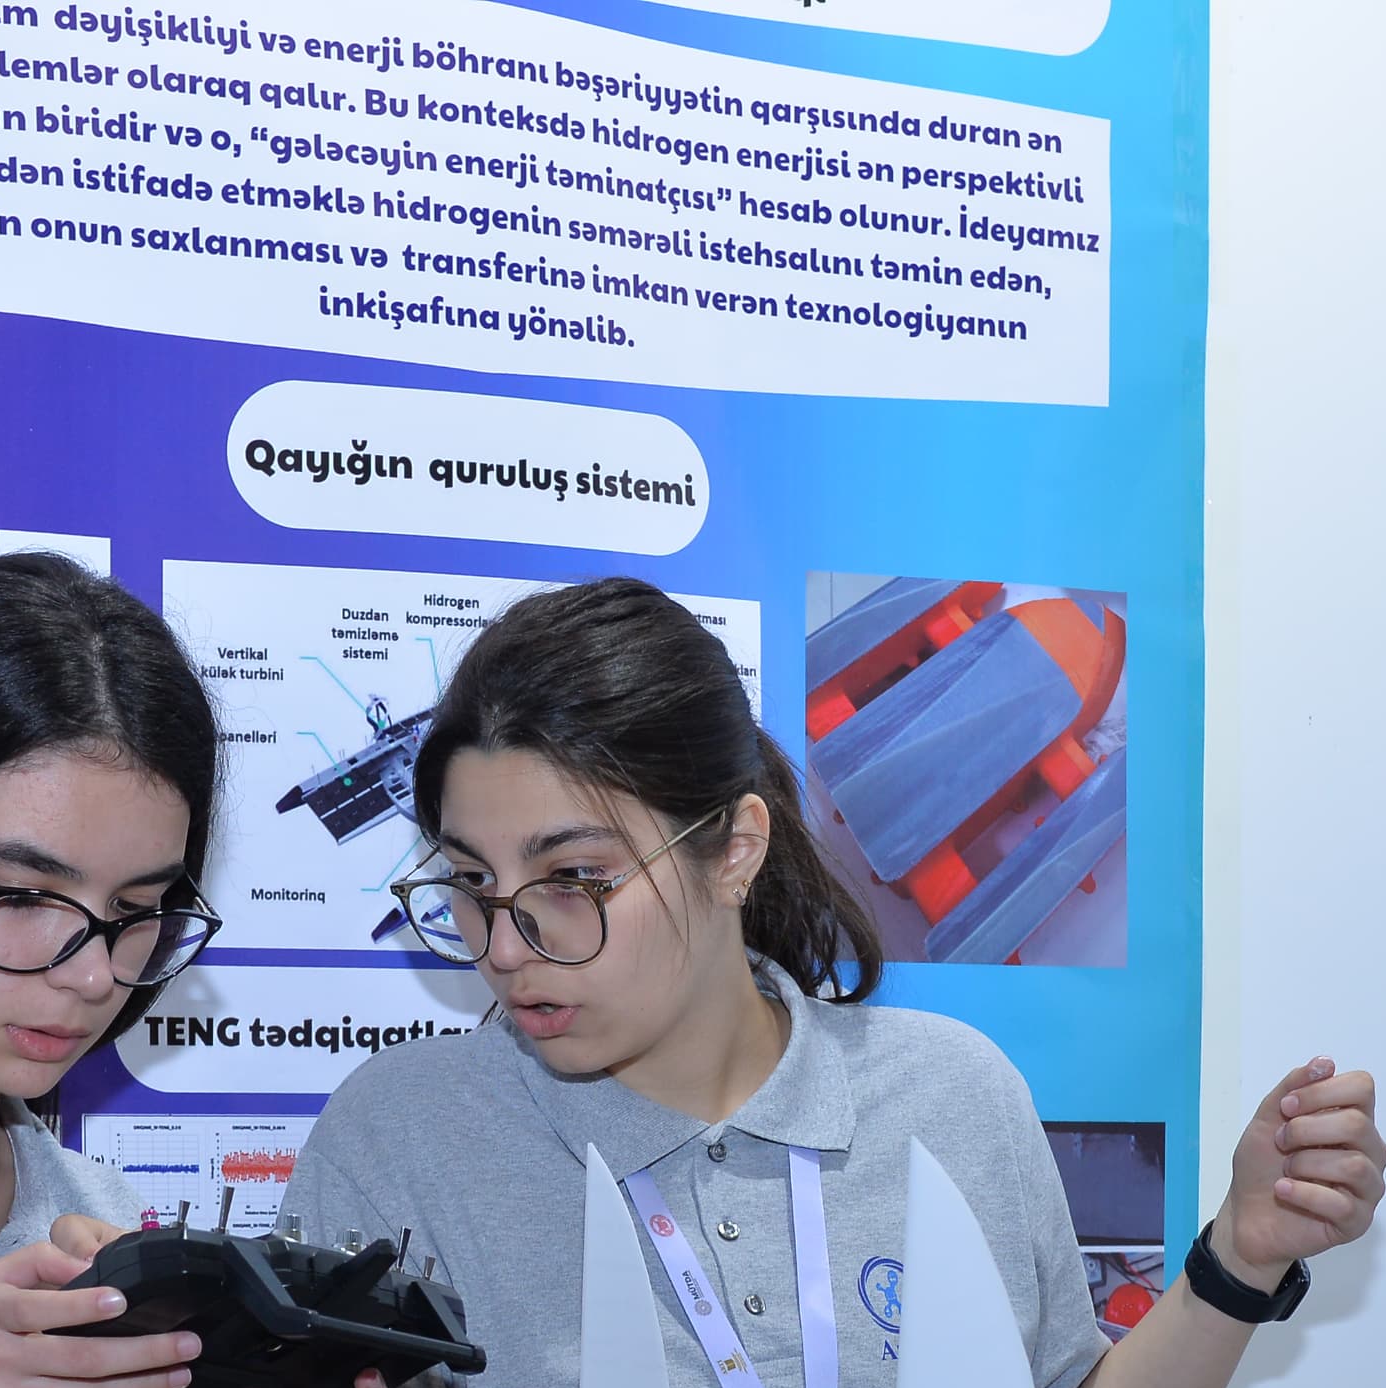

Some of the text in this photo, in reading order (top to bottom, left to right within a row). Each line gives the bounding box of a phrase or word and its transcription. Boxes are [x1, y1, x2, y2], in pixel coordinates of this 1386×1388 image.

[55, 5, 251, 54] dəyişikliyi
[259, 32, 295, 54] və
[305, 37, 404, 72] enerji
[413, 41, 548, 84] böhranı
[556, 62, 742, 116] bəşəriyyətin
[751, 101, 920, 136] qarşısında
[929, 116, 1020, 148] duran
[1028, 133, 1061, 153] ən
[127, 65, 250, 105] olaraq
[260, 83, 355, 112] qalır.
[365, 89, 408, 117] Bu
[419, 94, 585, 139] konteksdə
[593, 118, 728, 165] hidrogen
[737, 147, 851, 180] enerjisi
[858, 162, 893, 182] ən
[903, 166, 1083, 203] perspektivli
[320, 286, 634, 347] inkişafına yönəlib.
[245, 440, 695, 506] Qayığın quruluş sistemi
[424, 594, 479, 610] Hidrogen
[343, 608, 388, 621] Duzdan
[332, 628, 399, 641] təmizləmə
[218, 648, 267, 660] Vertikal
[343, 646, 388, 660] sistemi
[201, 665, 284, 680] külək turbini
[251, 888, 325, 904] Monitorinq
[145, 1017, 239, 1046] TENG
